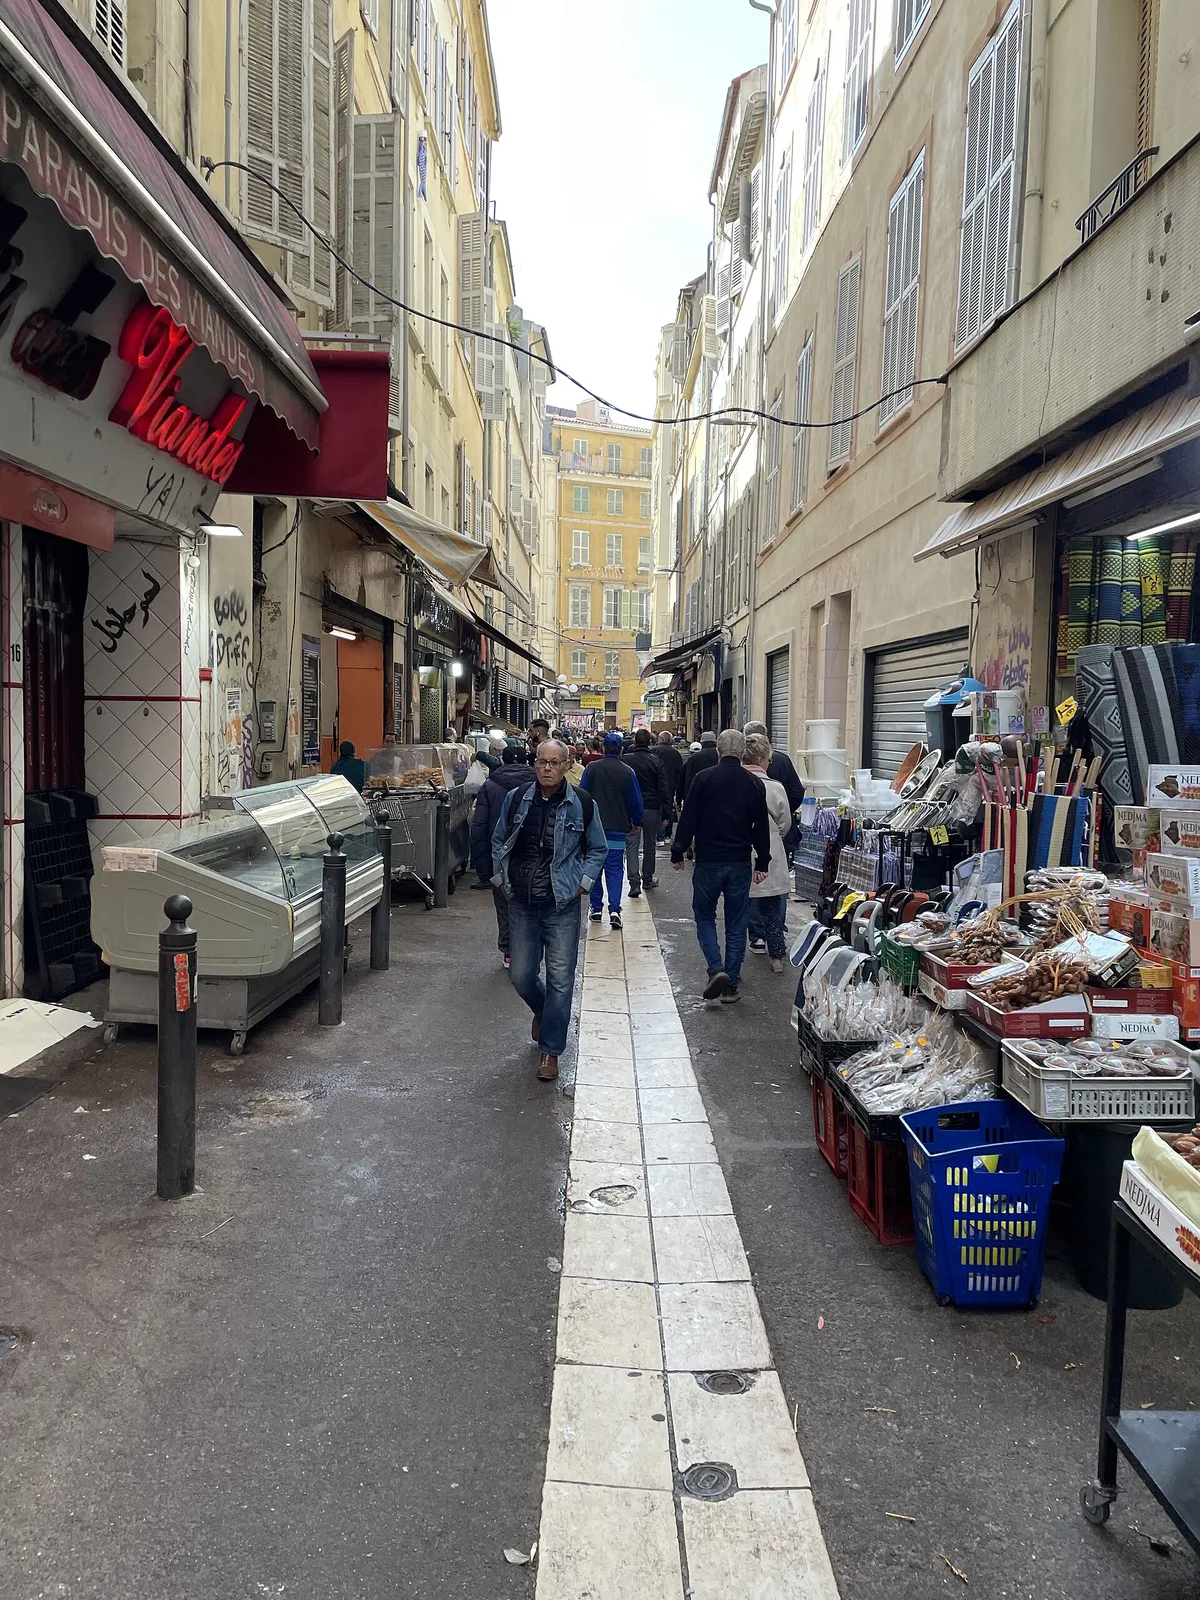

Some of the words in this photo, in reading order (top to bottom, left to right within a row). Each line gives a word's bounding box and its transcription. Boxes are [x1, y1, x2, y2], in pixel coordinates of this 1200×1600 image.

[2, 90, 129, 257] PARADIS
[140, 233, 181, 310] DES
[186, 279, 255, 384] VIANDES
[10, 643, 21, 663] 16
[1117, 808, 1148, 823] NEDJMA
[1180, 820, 1200, 833] NEDJ
[1151, 914, 1174, 933] NEDJMA
[1119, 1021, 1156, 1034] NEDJMA
[1124, 1174, 1162, 1228] NEDJMA
